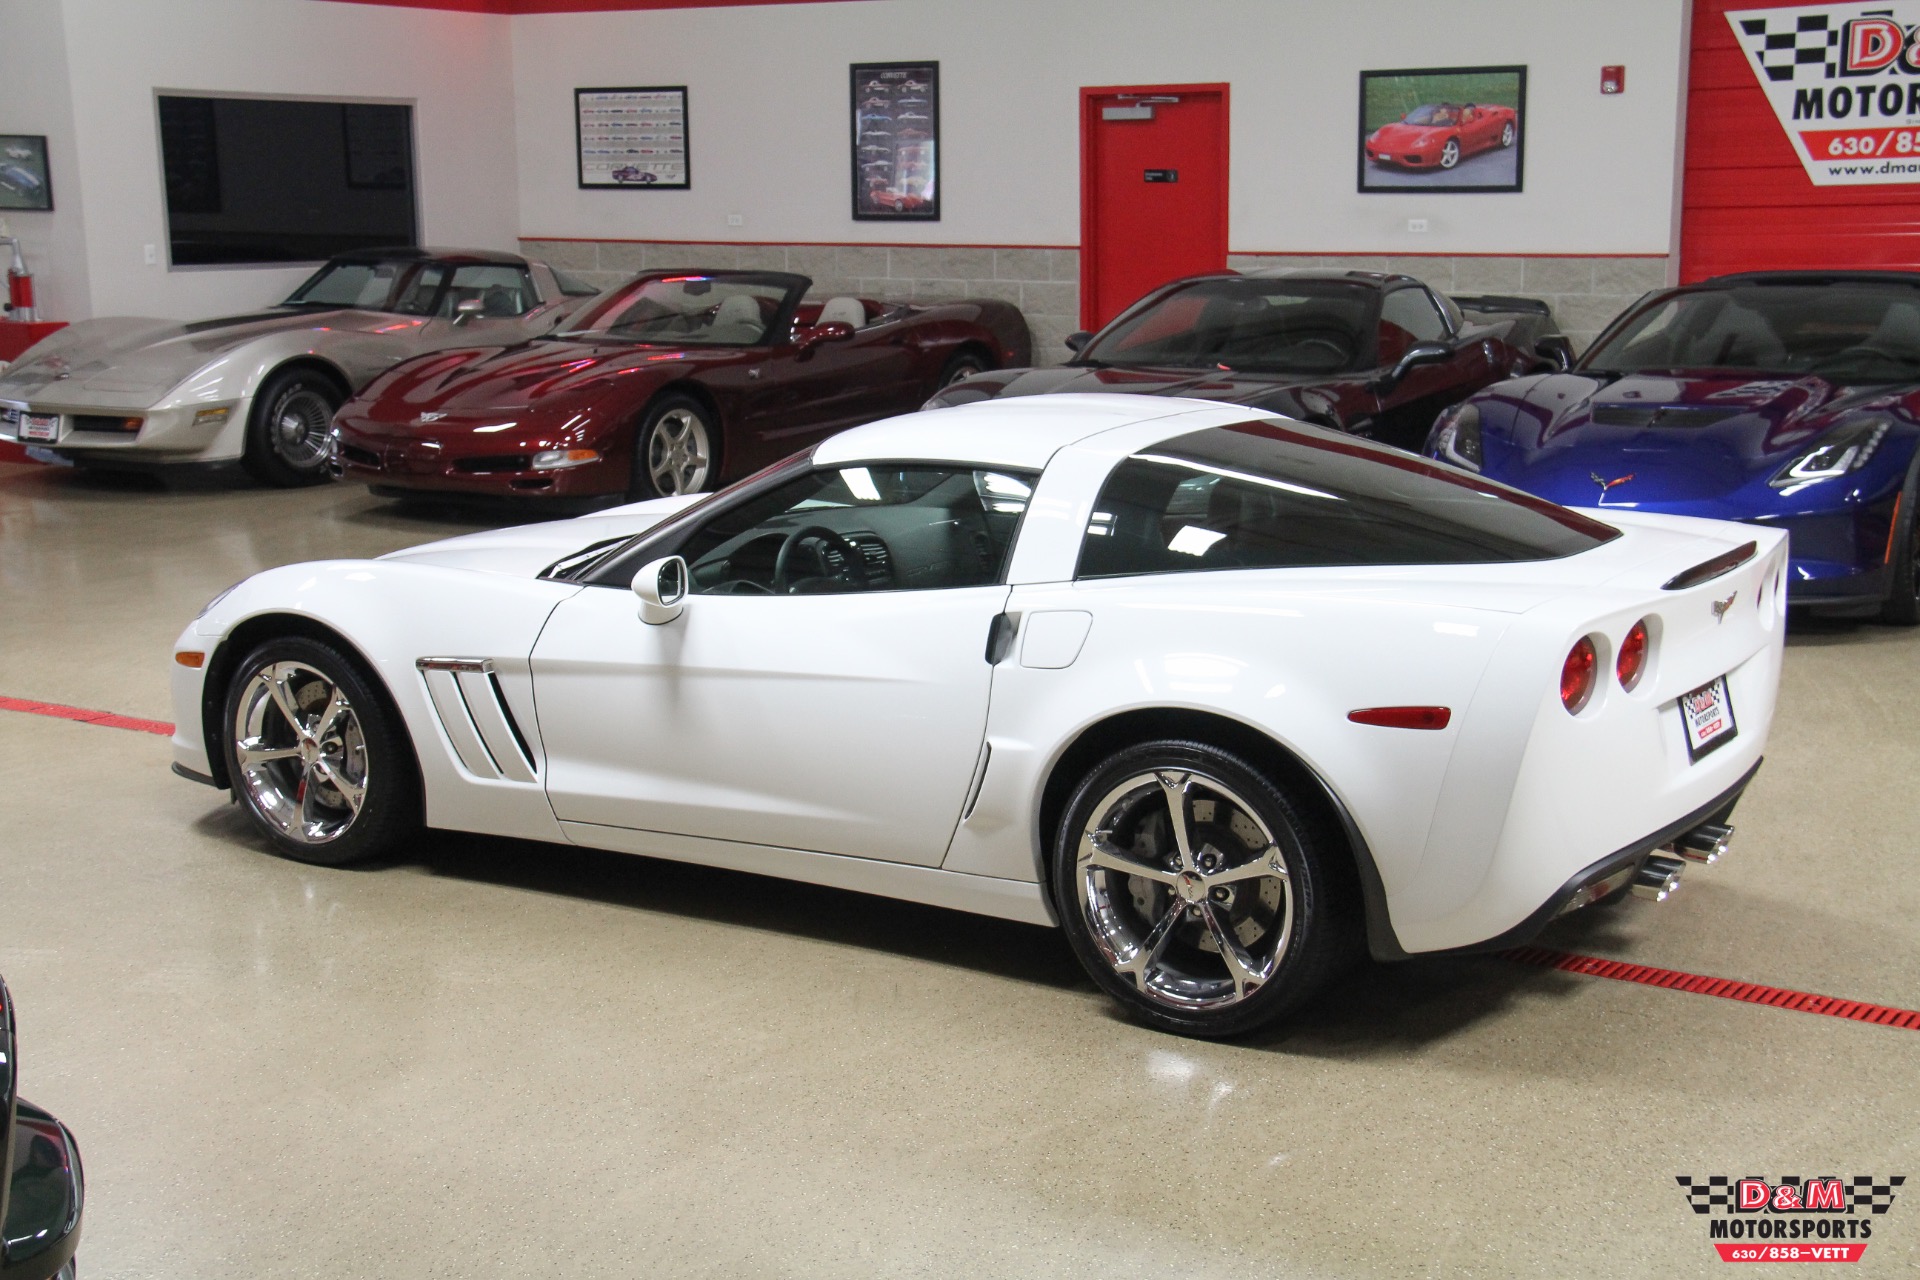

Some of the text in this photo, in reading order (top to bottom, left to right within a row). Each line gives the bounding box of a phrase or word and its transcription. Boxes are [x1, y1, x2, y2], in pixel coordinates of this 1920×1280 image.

[1839, 17, 1920, 78] D
[1792, 83, 1920, 120] MOTOR
[1828, 161, 1920, 176] www.dma
